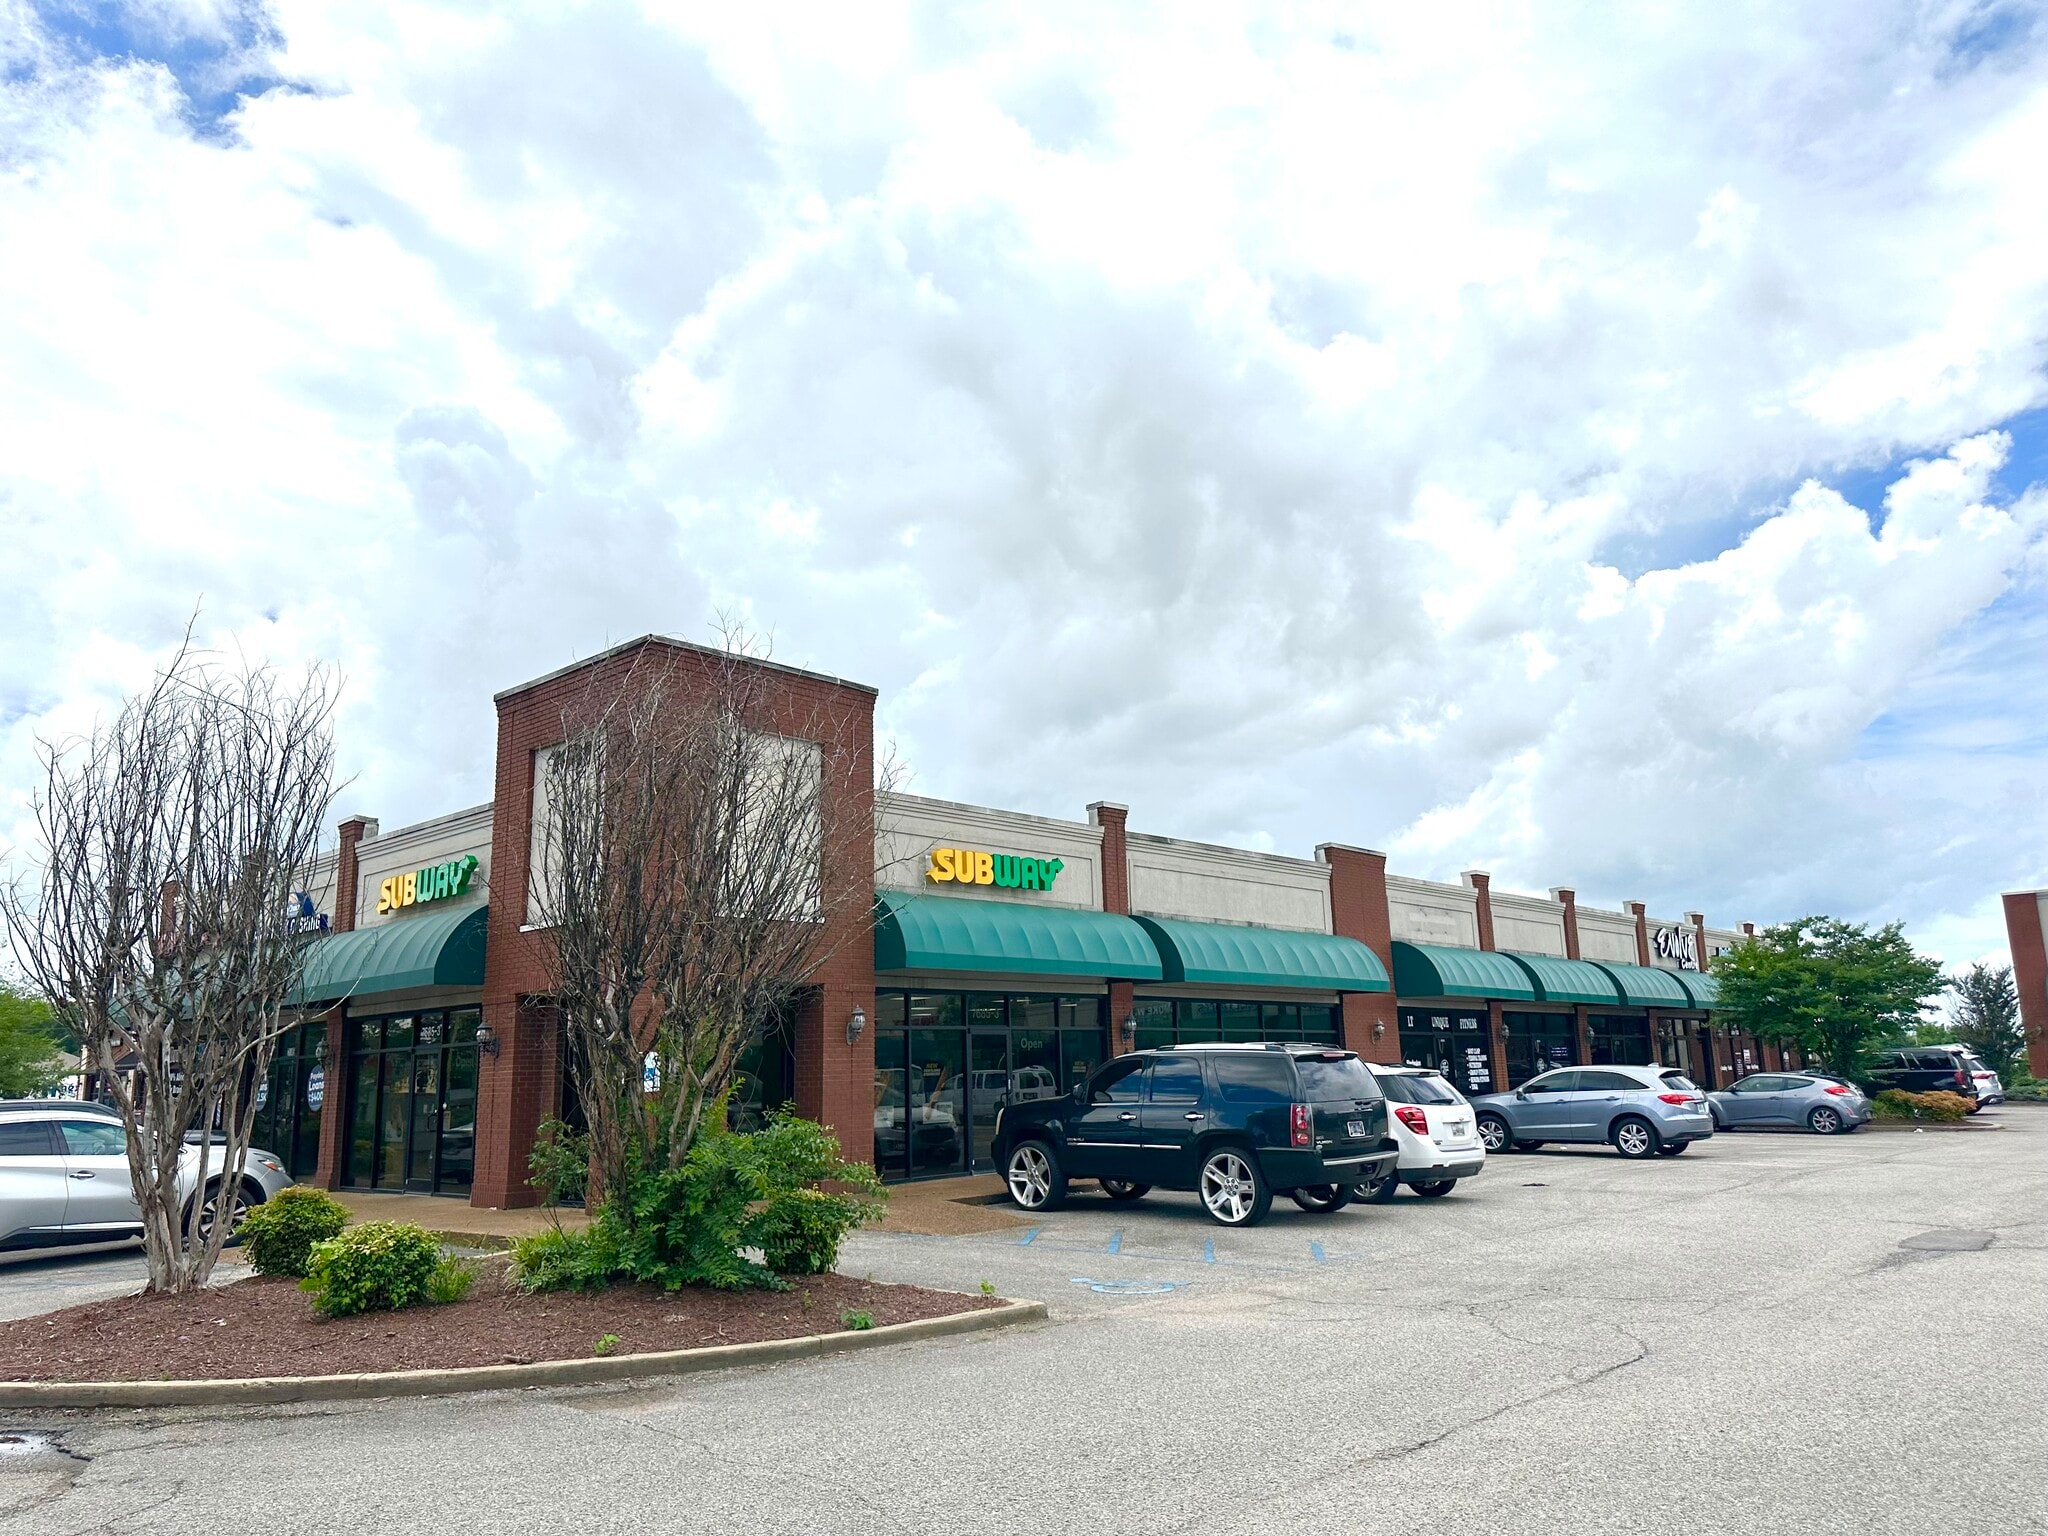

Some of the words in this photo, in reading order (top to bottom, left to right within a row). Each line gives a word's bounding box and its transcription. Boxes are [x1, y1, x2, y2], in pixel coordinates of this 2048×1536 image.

[376, 854, 479, 914] SUBWAY
[925, 848, 1065, 892] SUBWAY
[1020, 1038, 1043, 1051] Open
[308, 1081, 325, 1091] Loans
